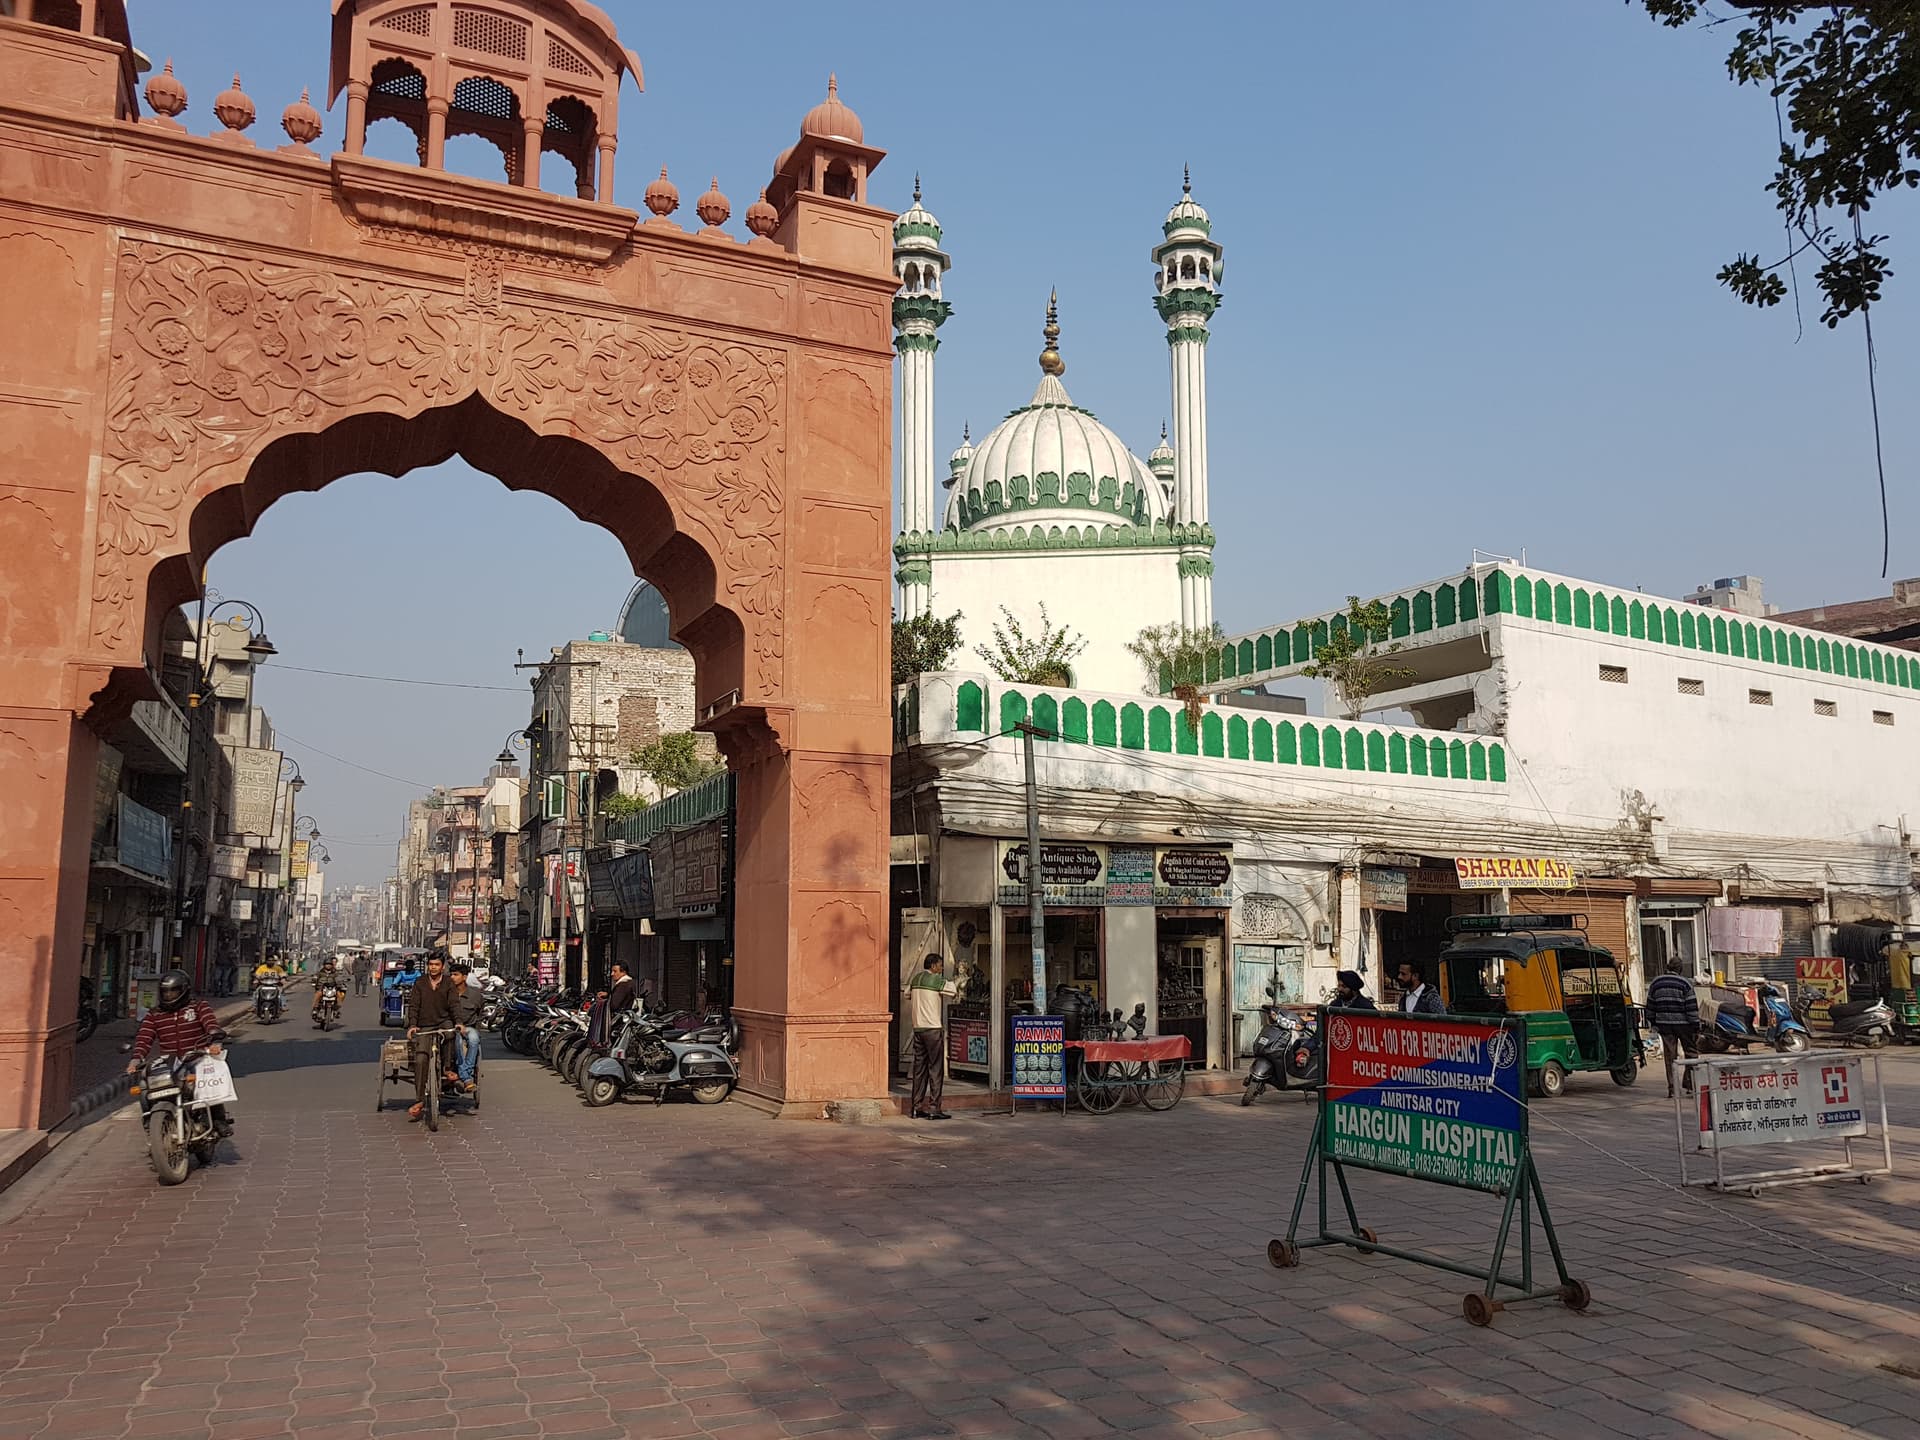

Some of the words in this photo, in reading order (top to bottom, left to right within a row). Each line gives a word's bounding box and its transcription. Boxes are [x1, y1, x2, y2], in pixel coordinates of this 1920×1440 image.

[1008, 851, 1029, 862] Ram
[1041, 853, 1075, 864] Antique
[1076, 853, 1098, 864] Shop
[1183, 857, 1191, 865] Old
[1008, 864, 1017, 874] All
[1057, 866, 1083, 875] Available
[1083, 865, 1097, 875] Here
[1456, 858, 1540, 878] SHARAN
[1545, 859, 1569, 878] AR
[1461, 879, 1476, 887] UBBER
[540, 942, 556, 952] RA
[1800, 959, 1842, 978] V.K.
[1015, 1027, 1063, 1041] RAMAN
[1014, 1043, 1039, 1053] ANTIQ
[1041, 1043, 1063, 1053] SHOP
[1356, 1026, 1378, 1052] CALL
[1401, 1030, 1420, 1058] FOR
[1422, 1032, 1480, 1065] EMERGENCY
[1353, 1060, 1386, 1080] POLICE
[1391, 1065, 1494, 1093] COMMISSIONERATE
[1381, 1091, 1433, 1113] AMRITSAR
[1435, 1098, 1460, 1117] CITY
[1334, 1104, 1410, 1145] HARGUN
[1422, 1119, 1517, 1167] HOSPITAL
[1334, 1137, 1357, 1158] BATALA
